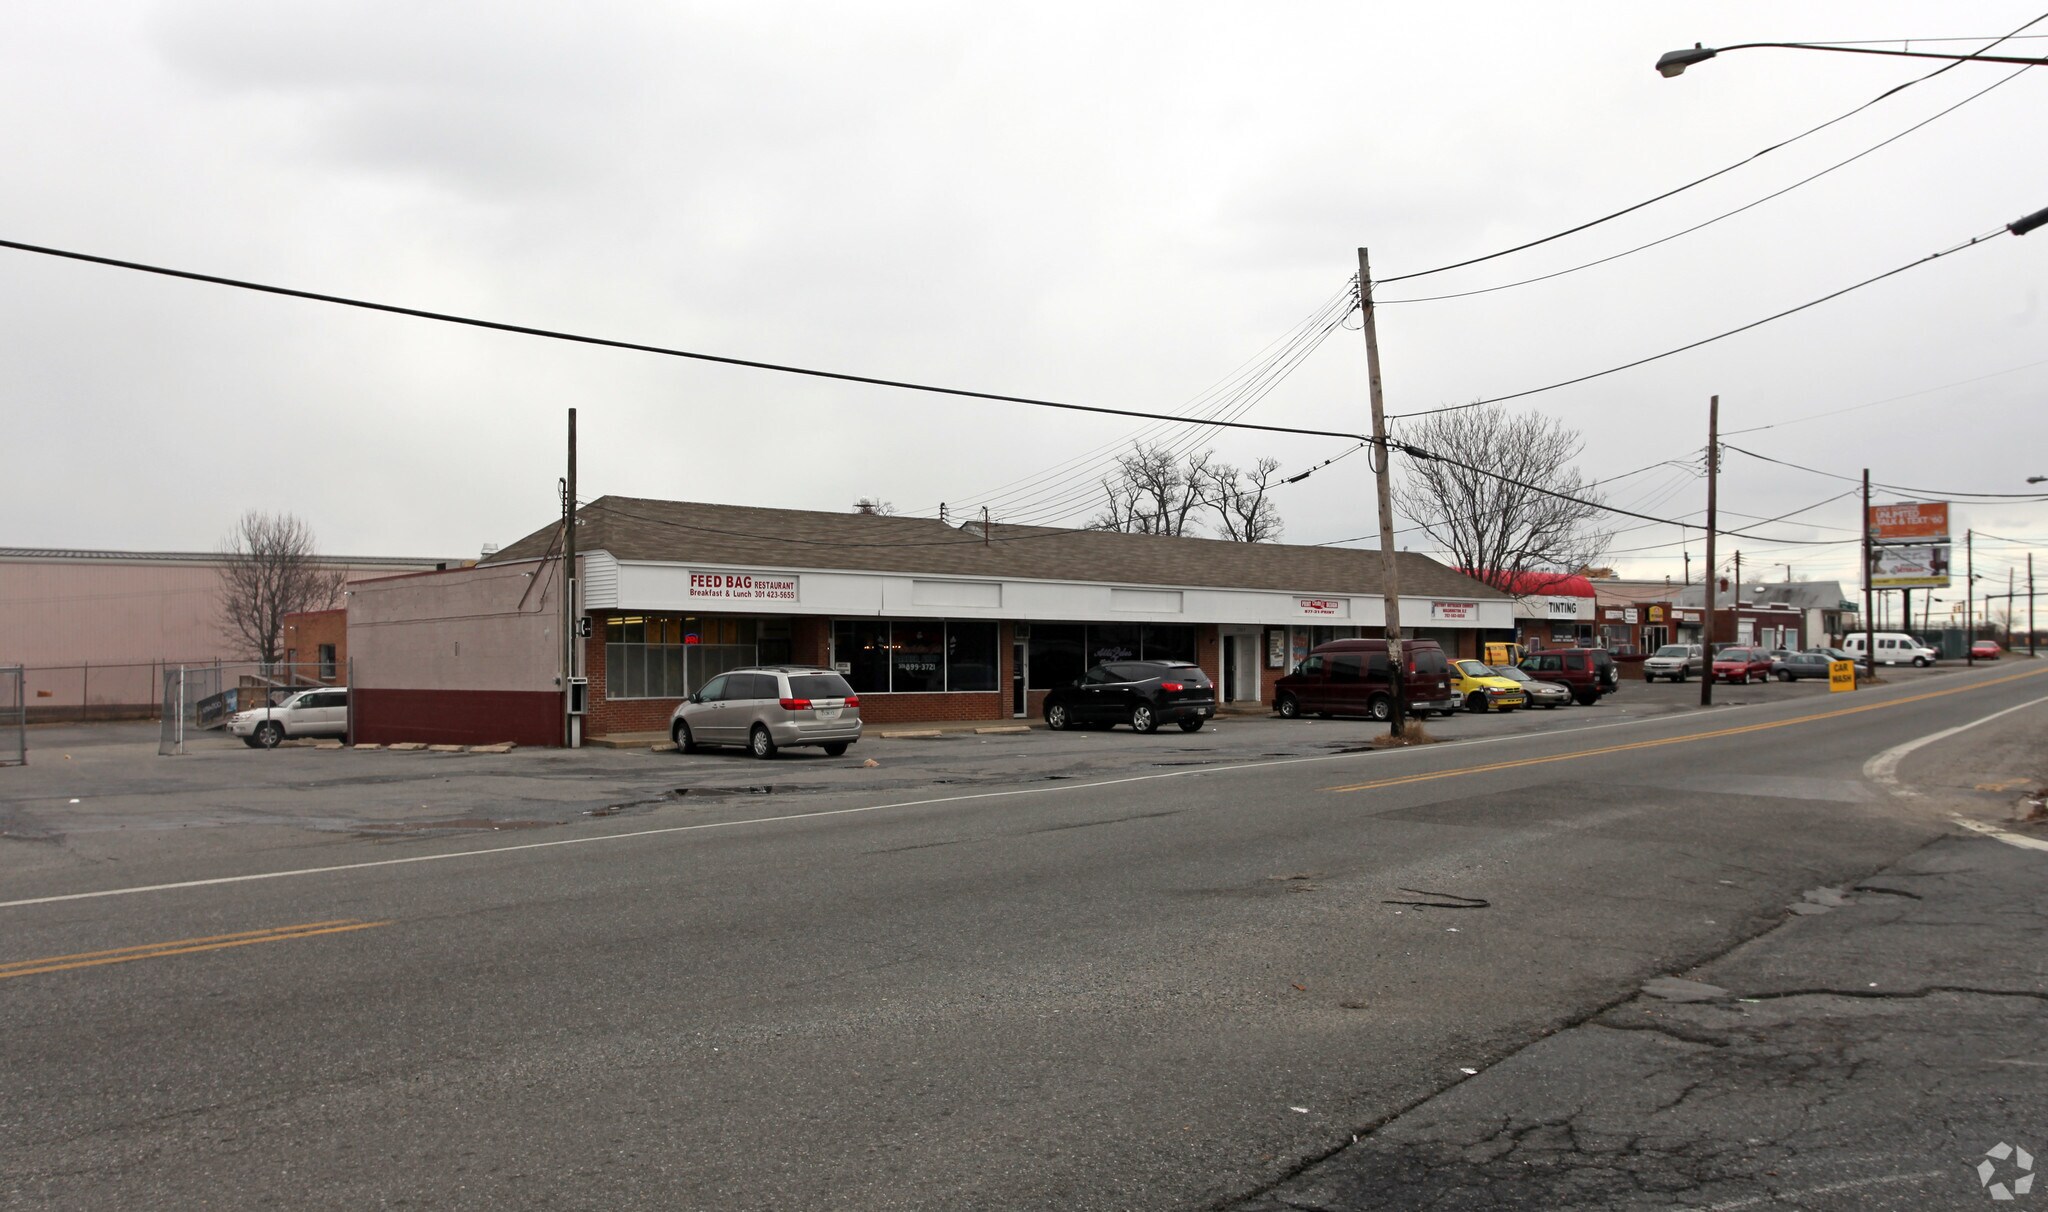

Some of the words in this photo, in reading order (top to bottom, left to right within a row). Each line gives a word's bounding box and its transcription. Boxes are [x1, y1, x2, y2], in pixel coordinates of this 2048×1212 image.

[1876, 510, 1920, 520] UNLIMITED
[1877, 518, 1897, 526] TALK
[1898, 517, 1904, 525] &
[1907, 516, 1928, 524] TEXT
[690, 574, 722, 588] FEED
[726, 576, 752, 588] BAG
[754, 581, 794, 590] RESTAURANT
[1549, 602, 1577, 614] TINTING
[1834, 663, 1848, 672] CAR
[1832, 674, 1852, 683] WASH
